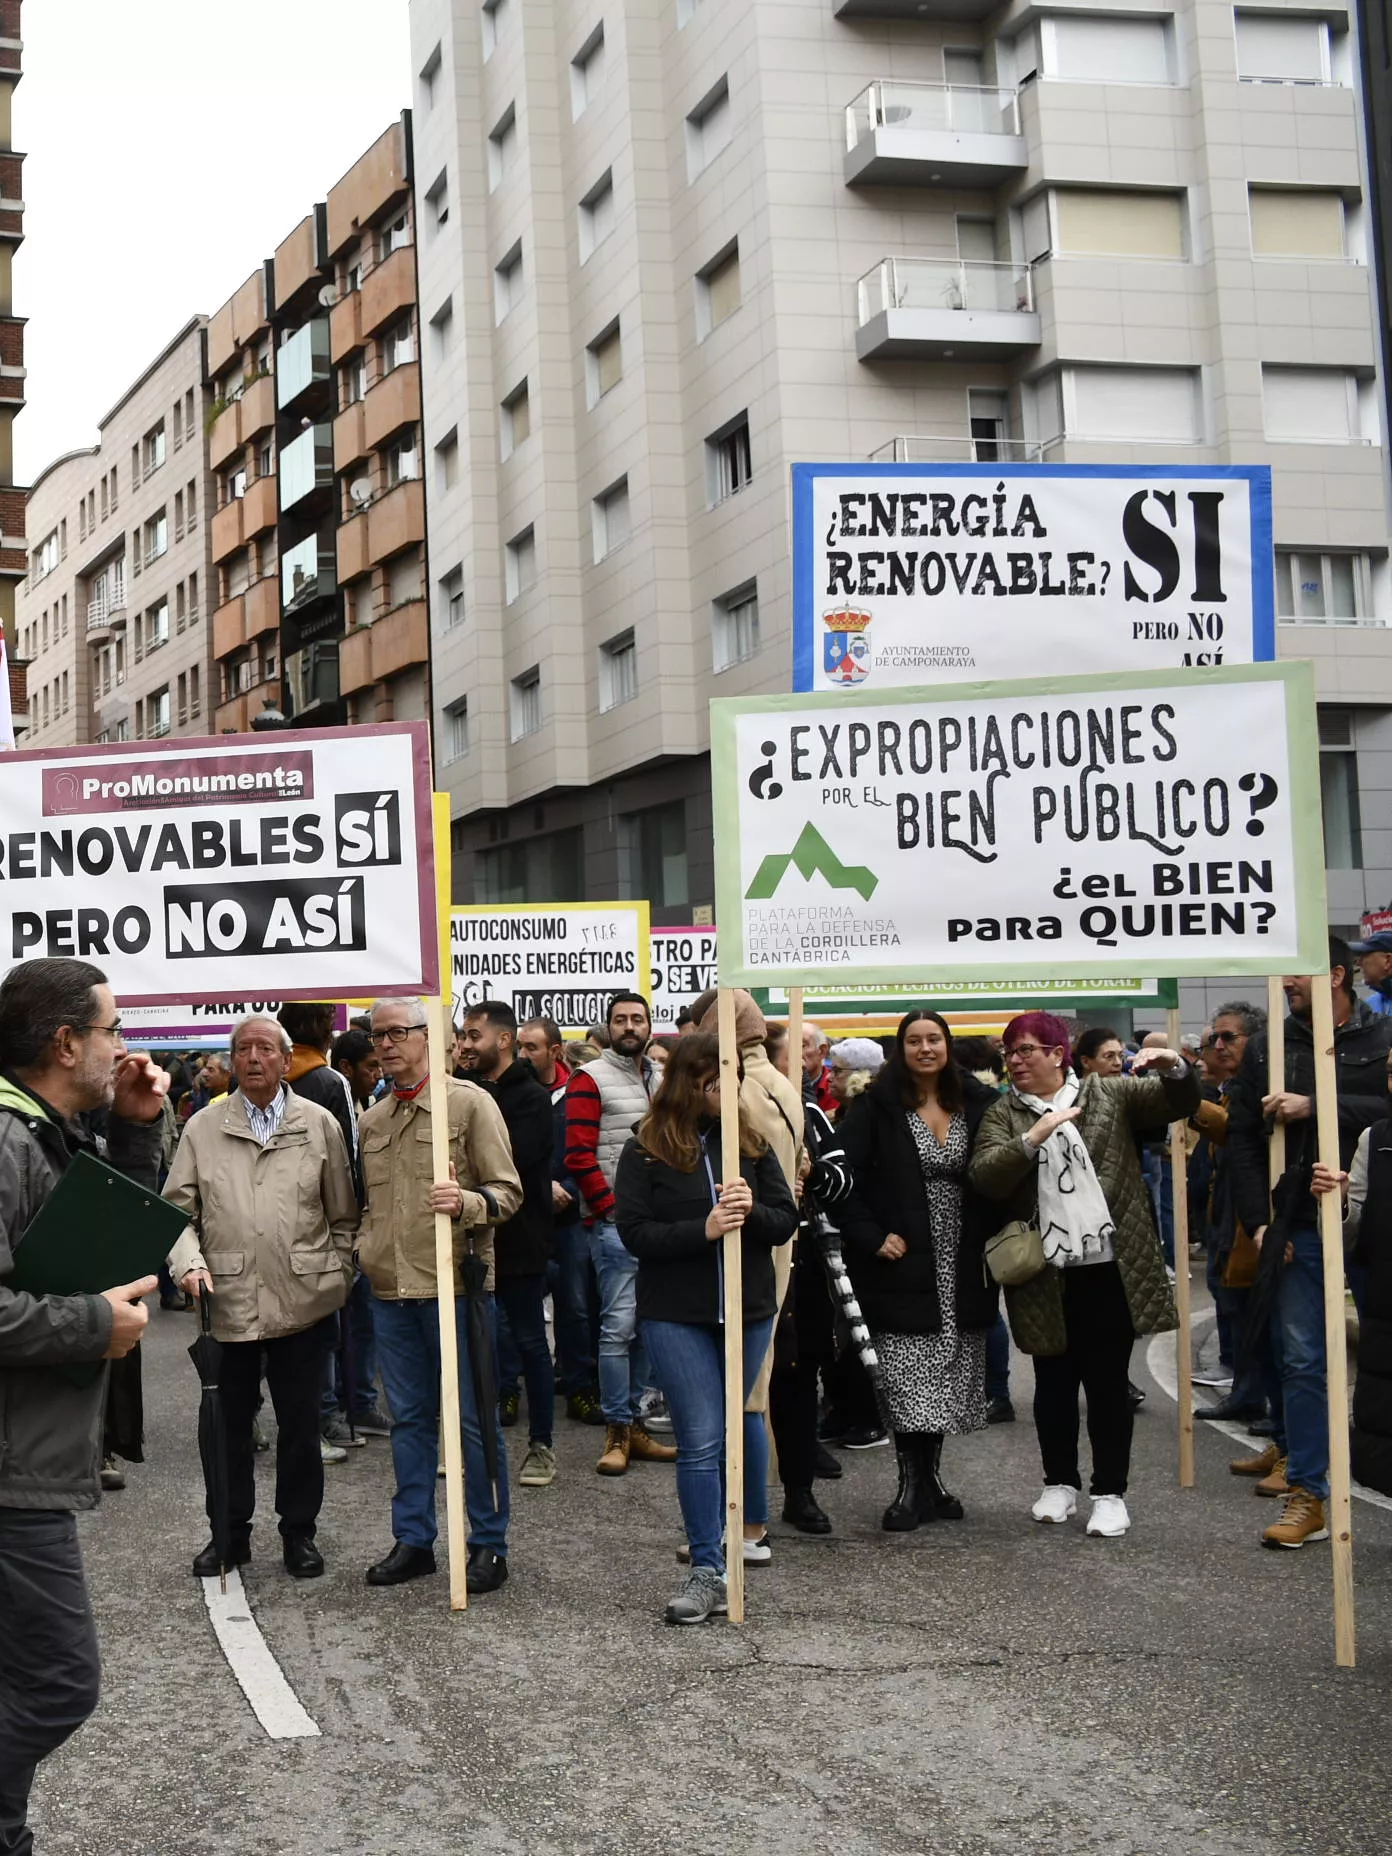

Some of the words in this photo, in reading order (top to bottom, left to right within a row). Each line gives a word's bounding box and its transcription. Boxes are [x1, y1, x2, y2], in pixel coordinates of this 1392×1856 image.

[826, 481, 1047, 547] ¿ENERGÍA
[1122, 489, 1228, 603] SI
[826, 550, 1111, 597] RENOVABLE?
[1132, 621, 1179, 641] PERO
[1187, 612, 1225, 642] NO
[875, 656, 890, 667] DE
[893, 656, 976, 668] CAMPONARAYA
[881, 646, 970, 657] AYUNTAMIENTO
[748, 703, 1177, 800] ¿EXPROPIACIONES
[82, 765, 304, 800] ProMonumenta
[822, 788, 858, 808] POR
[864, 785, 892, 807] EL
[339, 795, 390, 863] SÍ
[896, 768, 1012, 864] BIEN
[1153, 861, 1273, 897] BIEN
[11, 905, 152, 959] PERO
[168, 899, 248, 954] NO
[262, 879, 356, 949] ASÍ
[748, 906, 854, 921] PLATAFORMA
[749, 922, 790, 936] PARA
[796, 921, 816, 935] LA
[821, 919, 896, 934] DEFENSA
[1080, 901, 1277, 948] QUIEN?
[451, 917, 568, 942] AUTOCONSUMO
[749, 937, 769, 950] DE
[775, 937, 795, 950] LA
[800, 933, 902, 949] CORDILLERA
[451, 952, 522, 977] NIDADES
[526, 947, 635, 975] ENERGÉTICAS
[650, 939, 693, 962] TRO
[749, 949, 851, 964] CANTÁBRICA
[669, 965, 692, 992] SE
